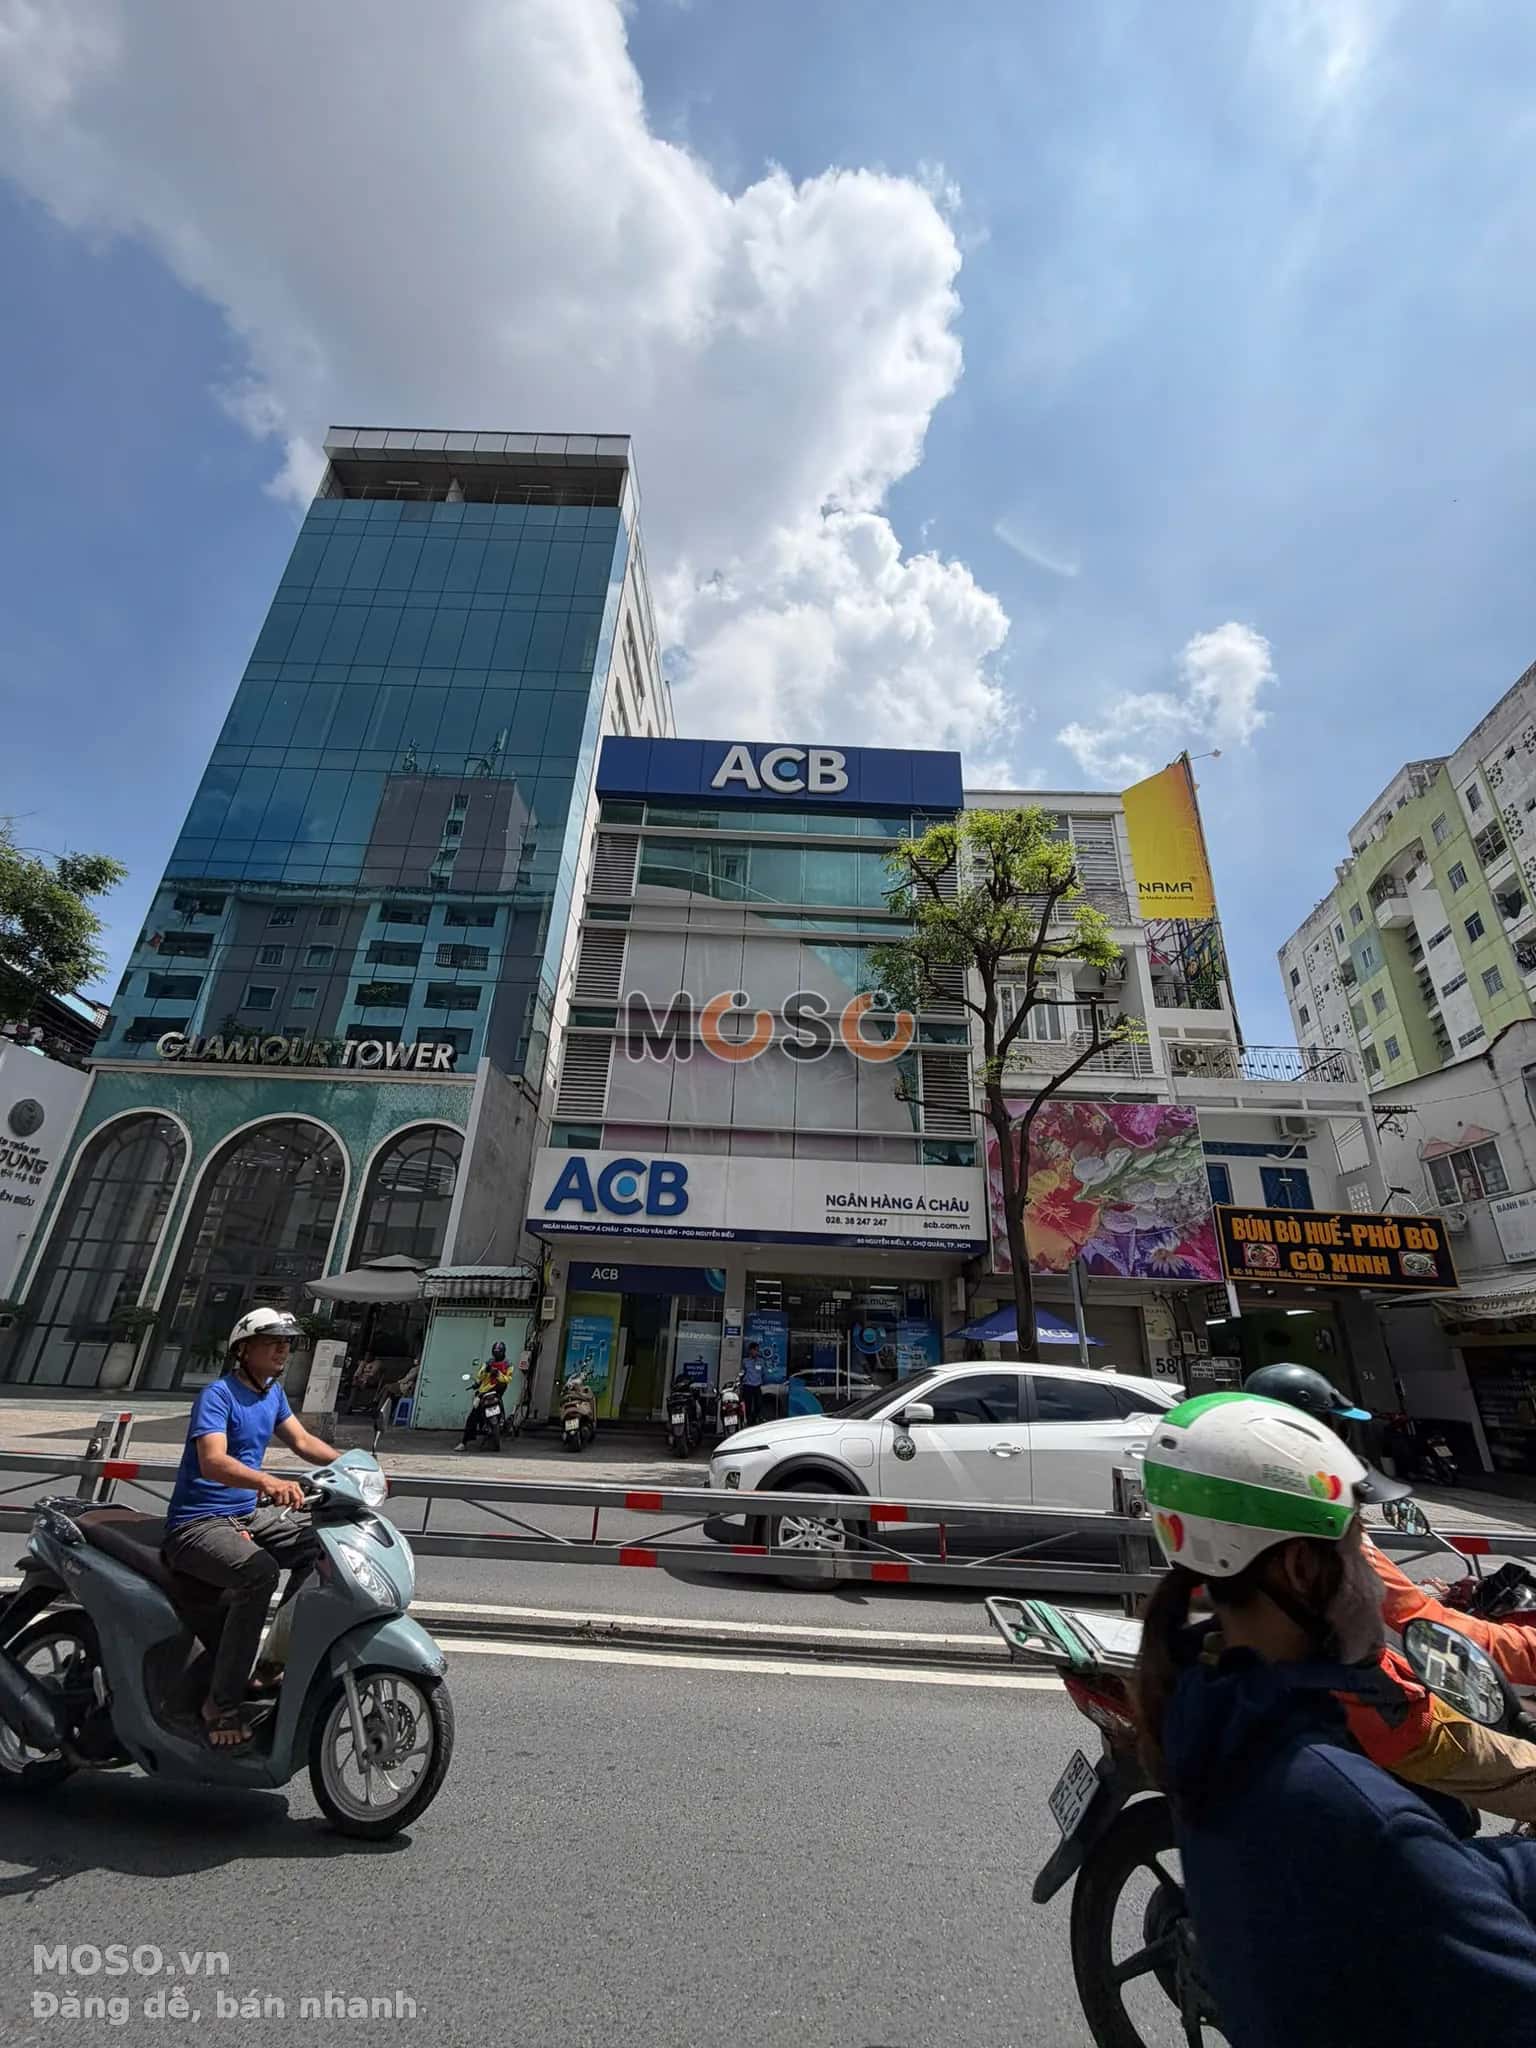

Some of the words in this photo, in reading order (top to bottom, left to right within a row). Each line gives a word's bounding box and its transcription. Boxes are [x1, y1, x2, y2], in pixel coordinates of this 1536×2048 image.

[711, 745, 849, 794] ACB
[1138, 882, 1193, 893] NAMA
[156, 1031, 331, 1067] GLAMOUR
[340, 1039, 455, 1069] TOWER
[544, 1156, 690, 1216] ACB
[825, 1192, 867, 1208] NGÂN
[870, 1194, 913, 1209] HÀNG
[916, 1195, 926, 1210] Á
[929, 1197, 969, 1212] CHÂU
[601, 1225, 619, 1233] CHÂU
[825, 1216, 843, 1224] 028.
[856, 1218, 871, 1226] 247
[873, 1218, 888, 1227] 247
[923, 1221, 971, 1231] acb.com.vn
[1231, 1213, 1273, 1242] BÚN
[1273, 1215, 1301, 1243] BÒ
[1404, 1221, 1439, 1251] BÒ
[1289, 1248, 1325, 1271] CÔ
[1329, 1252, 1391, 1276] XINH
[591, 1267, 619, 1280] ACB
[1037, 1327, 1073, 1338] ACB
[1155, 1358, 1177, 1374] 58
